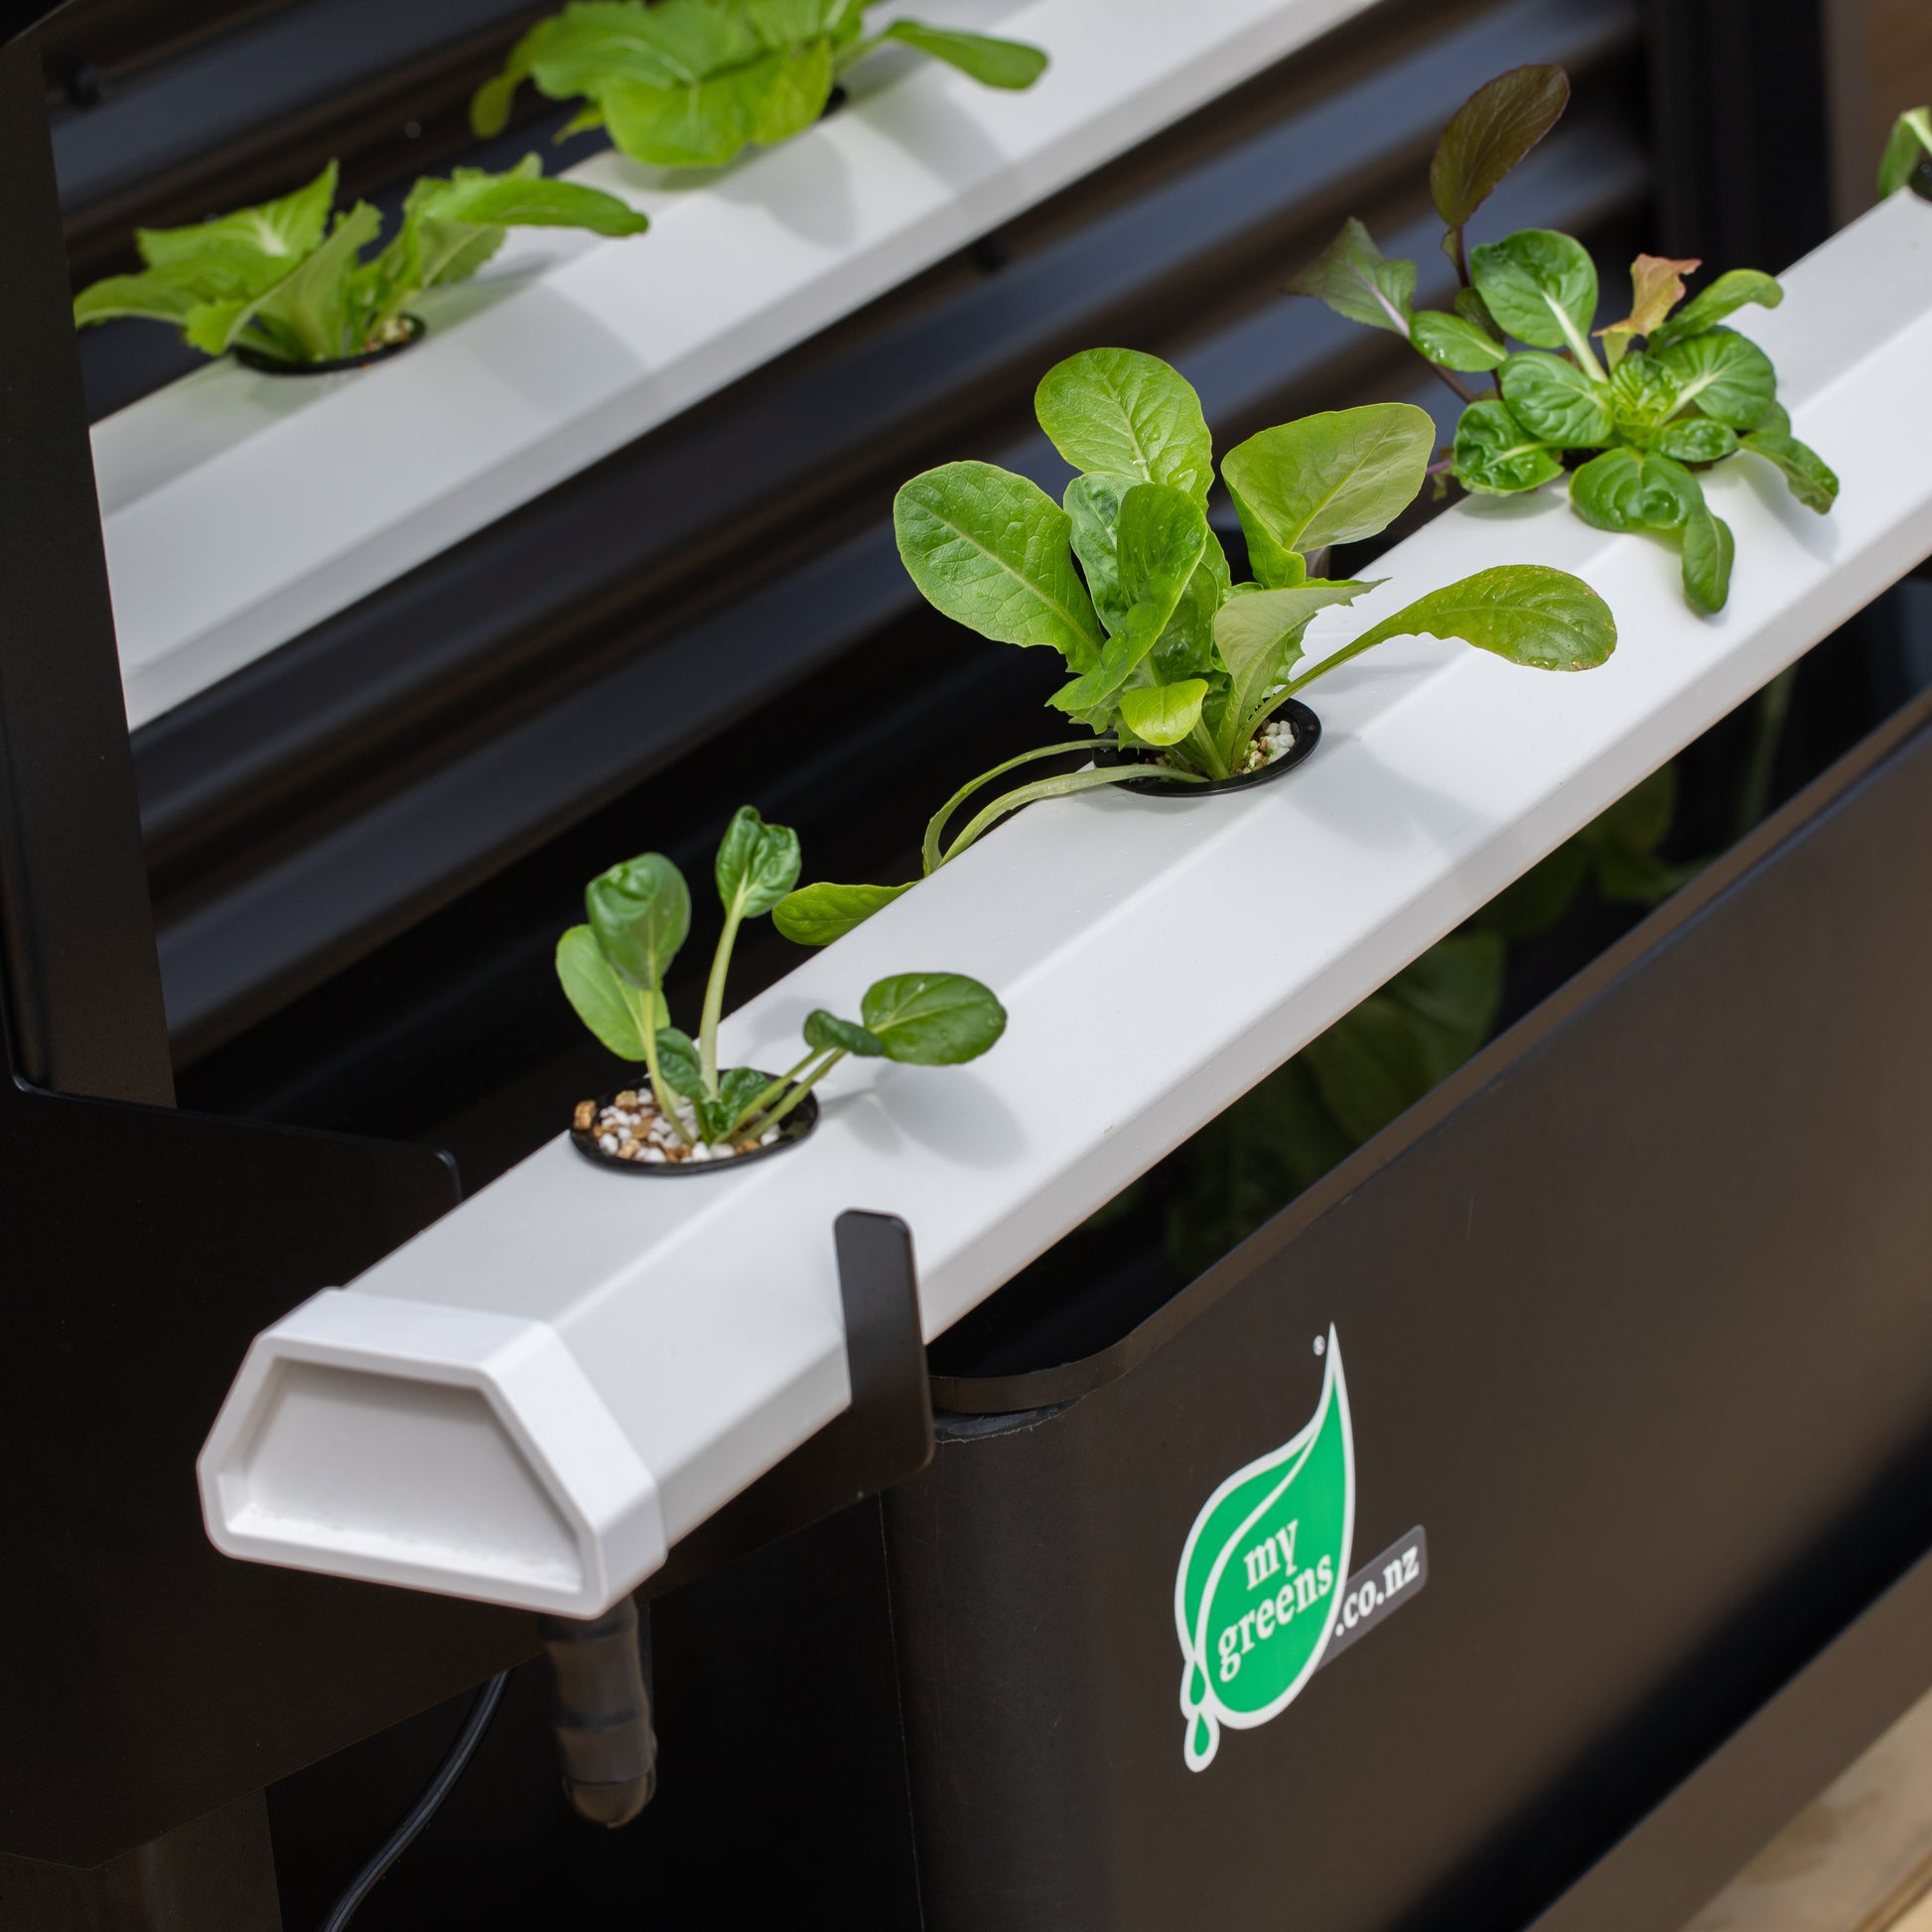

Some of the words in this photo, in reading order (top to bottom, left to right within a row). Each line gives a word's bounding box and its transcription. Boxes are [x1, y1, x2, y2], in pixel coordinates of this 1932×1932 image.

[1244, 1519, 1299, 1590] my
[1218, 1554, 1333, 1683] greens
[1335, 1546, 1419, 1636] .co.nz
